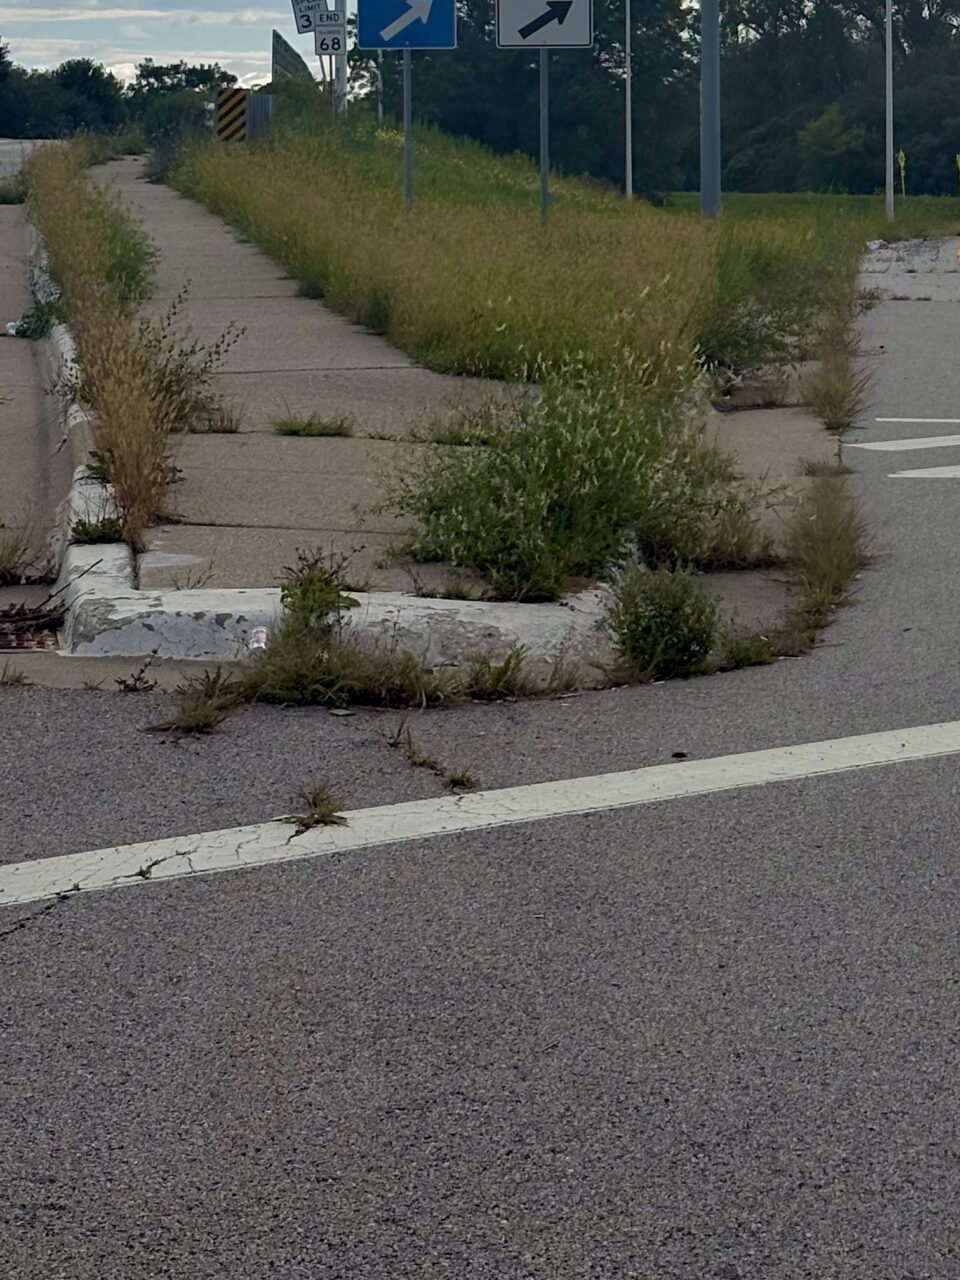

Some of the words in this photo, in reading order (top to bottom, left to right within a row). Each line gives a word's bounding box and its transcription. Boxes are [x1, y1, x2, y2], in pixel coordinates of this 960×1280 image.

[299, 3, 321, 13] LIMIT
[300, 14, 312, 29] 3
[319, 13, 340, 23] END
[320, 37, 341, 51] 68
